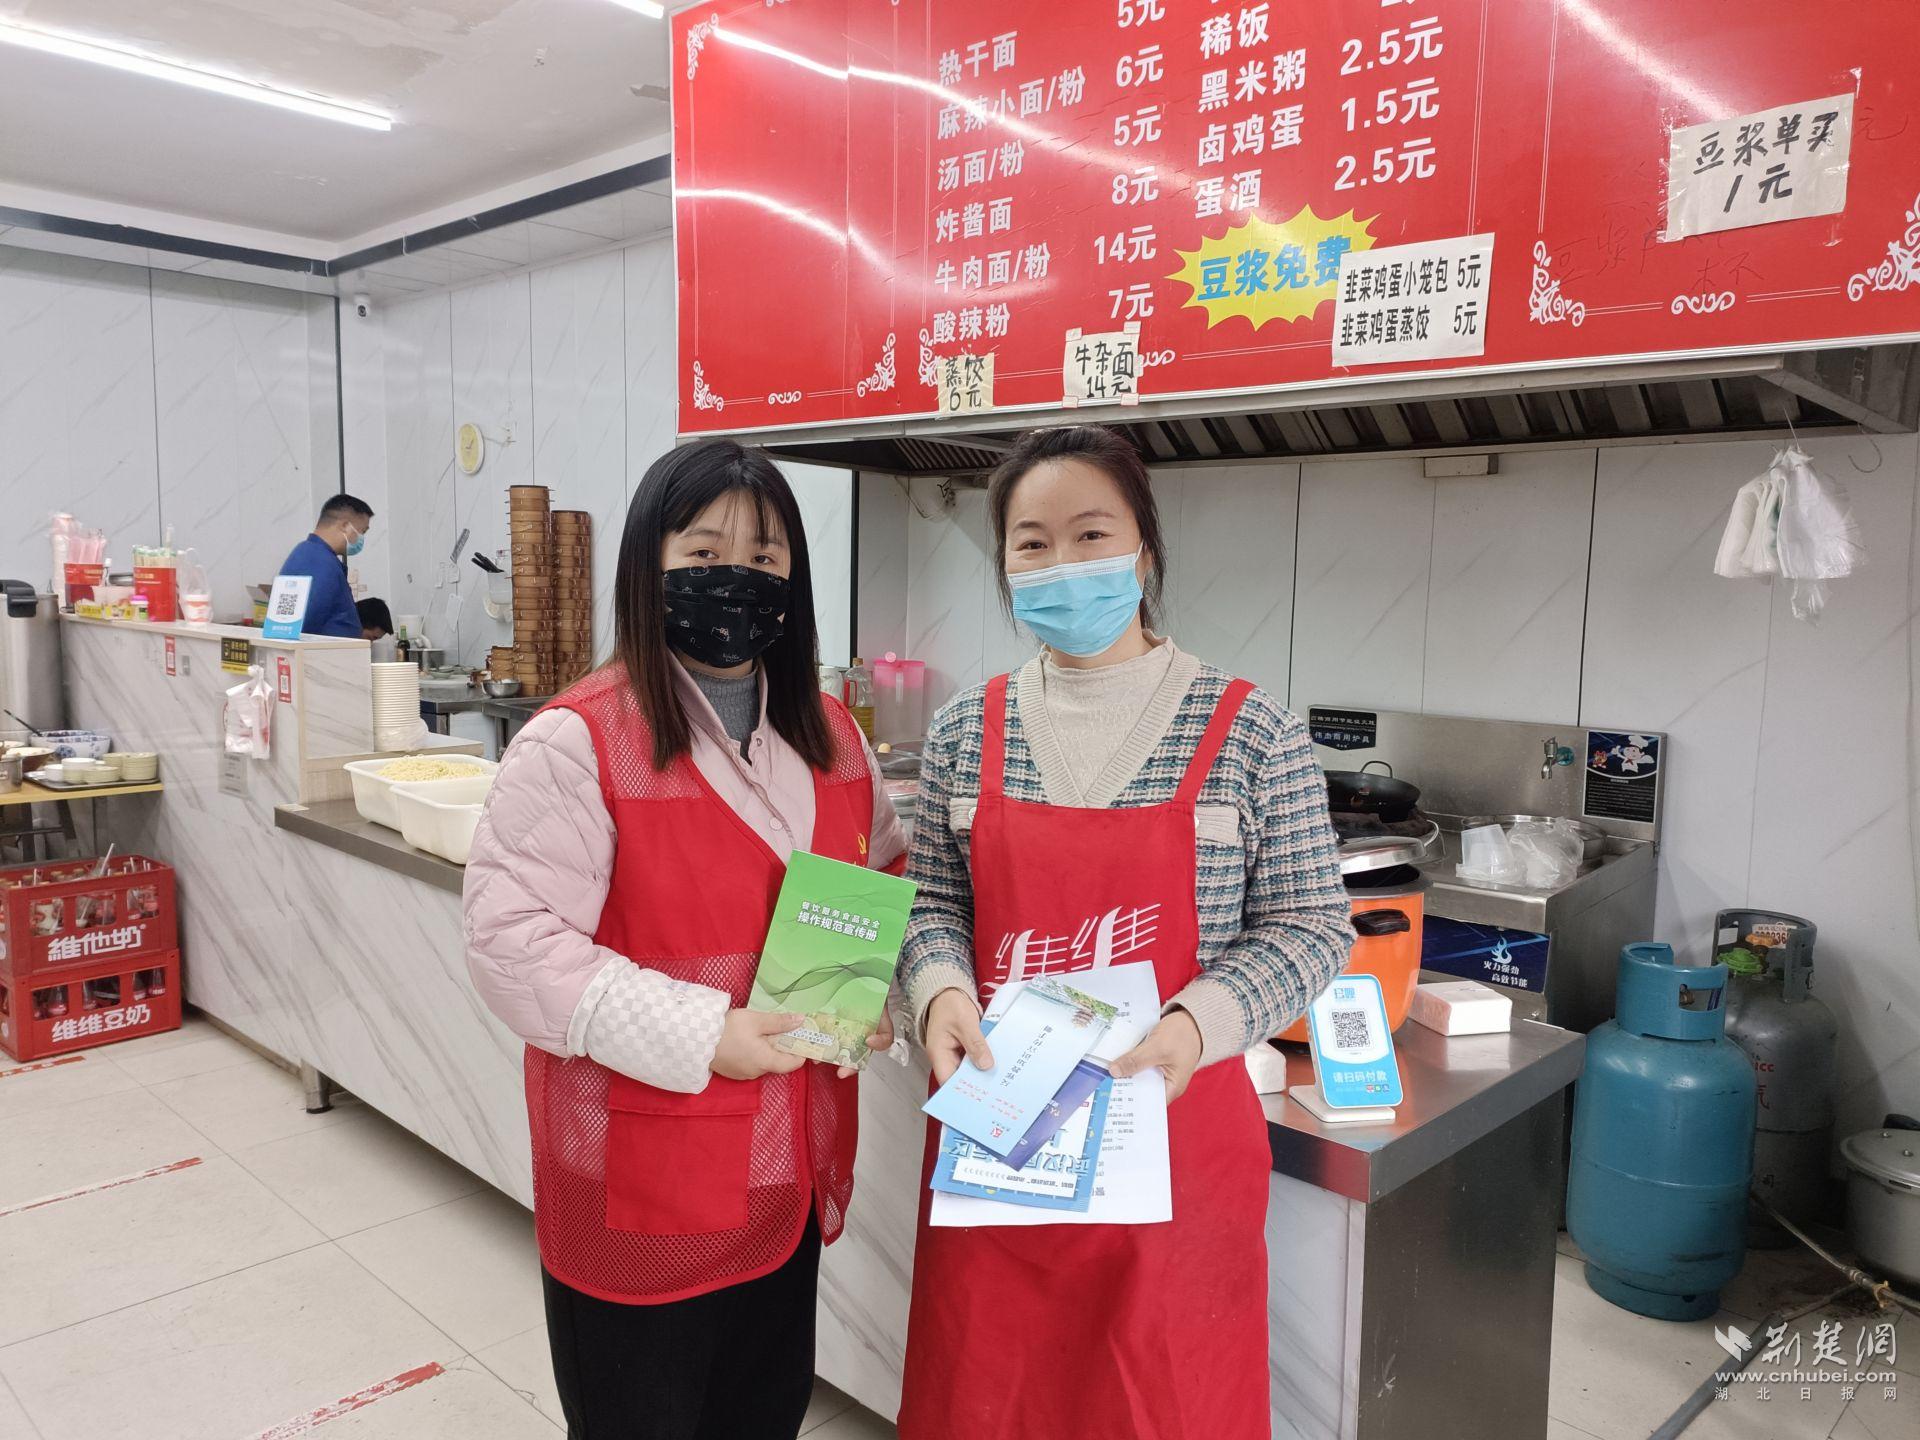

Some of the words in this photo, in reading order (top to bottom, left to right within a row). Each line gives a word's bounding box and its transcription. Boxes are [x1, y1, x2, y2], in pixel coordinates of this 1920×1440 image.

[938, 30, 1018, 88] 热干面
[1200, 2, 1270, 59] 稀饭
[938, 65, 1085, 140] 麻辣小面/粉
[1116, 45, 1163, 88] 6元
[1199, 48, 1307, 112] 黑米粥
[1340, 16, 1444, 77] 2.5元
[937, 139, 1024, 191] 汤面/粉
[1113, 105, 1161, 147] 5元
[1197, 106, 1304, 167] 卤鸡蛋
[1340, 76, 1440, 133] 1.5元
[1693, 111, 1839, 175] 豆浆单买
[936, 196, 1013, 244] 炸酱面
[1111, 166, 1159, 206] 8元
[1195, 169, 1261, 220] 蛋酒
[1334, 138, 1437, 192] 2.5元
[935, 242, 1050, 294] 牛肉面/粉
[1093, 225, 1157, 266] 14元
[1199, 235, 1352, 300] 豆浆免费
[1345, 259, 1448, 304] 韭菜鸡蛋小笼包
[1457, 254, 1481, 291] 5元
[933, 302, 1010, 345] 酸辣粉
[1108, 283, 1154, 321] 7元
[1340, 307, 1430, 348] 韭菜鸡蛋蒸饺
[1453, 301, 1477, 336] 5元
[1075, 341, 1134, 378] 牛杂面
[1087, 376, 1131, 398] 14元
[949, 384, 983, 411] 6元
[48, 924, 142, 962] 維他奶
[797, 911, 878, 942] 操作规范宣传册
[1483, 960, 1520, 976] 火力强劲
[1491, 973, 1528, 988] 高效节能
[52, 1003, 151, 1042] 维维豆奶
